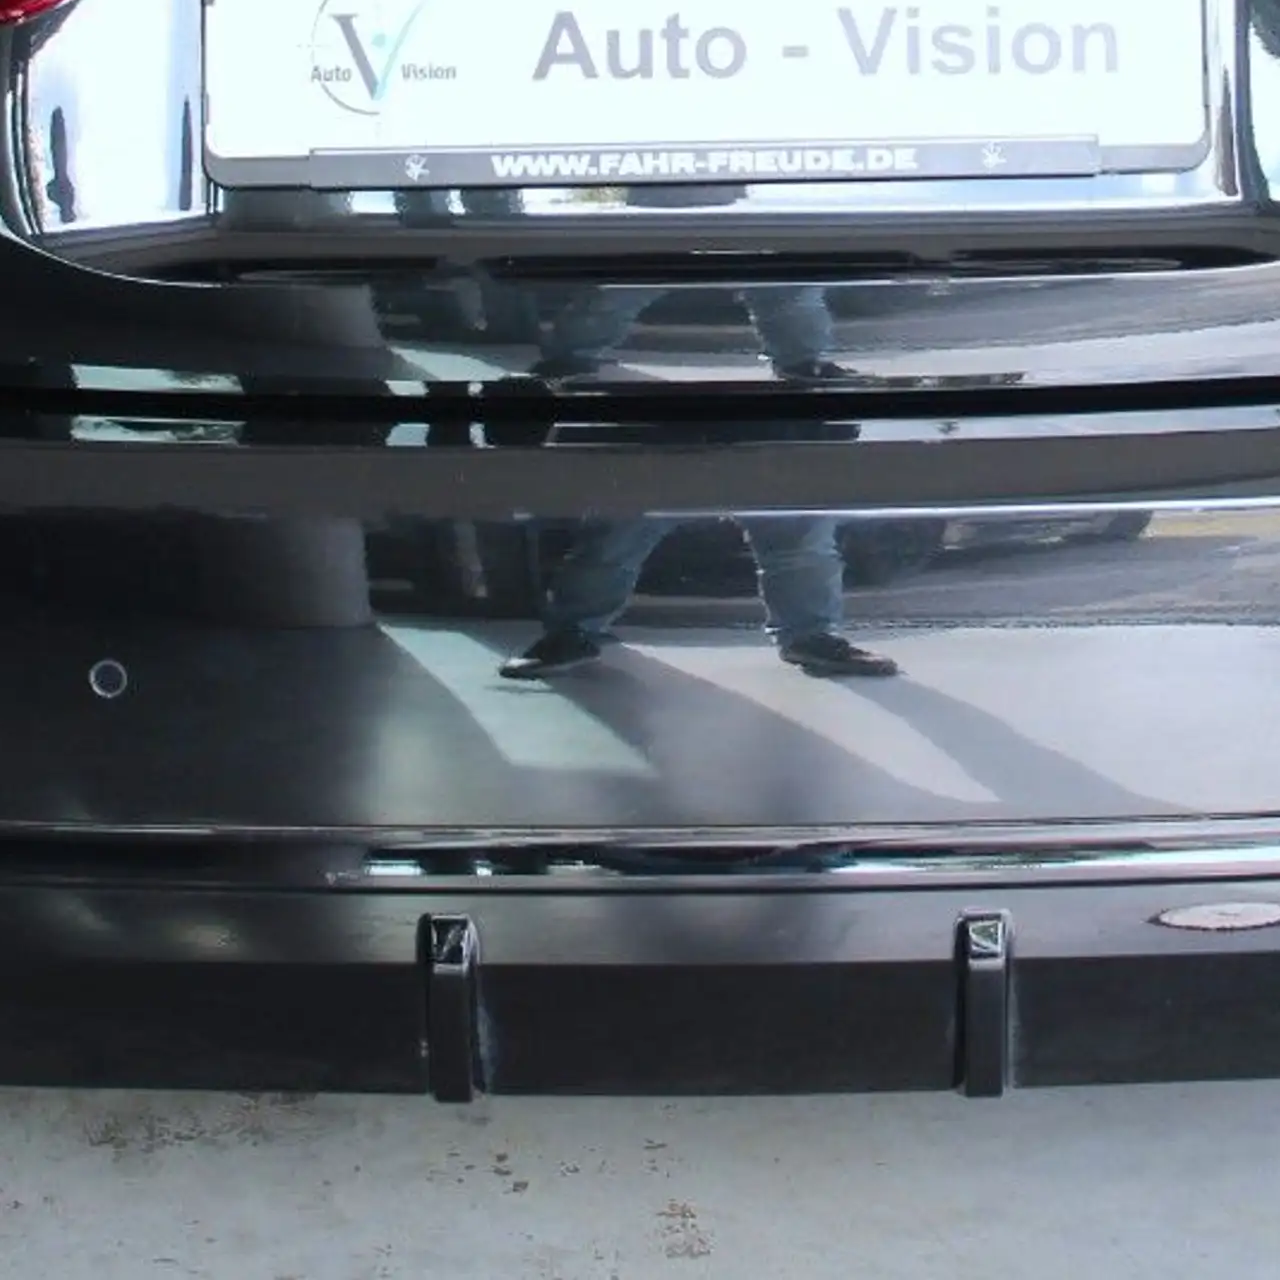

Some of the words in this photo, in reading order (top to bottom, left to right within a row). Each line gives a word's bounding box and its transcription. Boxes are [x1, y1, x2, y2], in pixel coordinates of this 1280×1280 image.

[532, 9, 747, 82] Auto
[837, 4, 1119, 76] Vision
[311, 65, 352, 82] Auto
[402, 63, 457, 80] Vision
[491, 148, 919, 177] WWW.FAHR-FREUDE.DE
